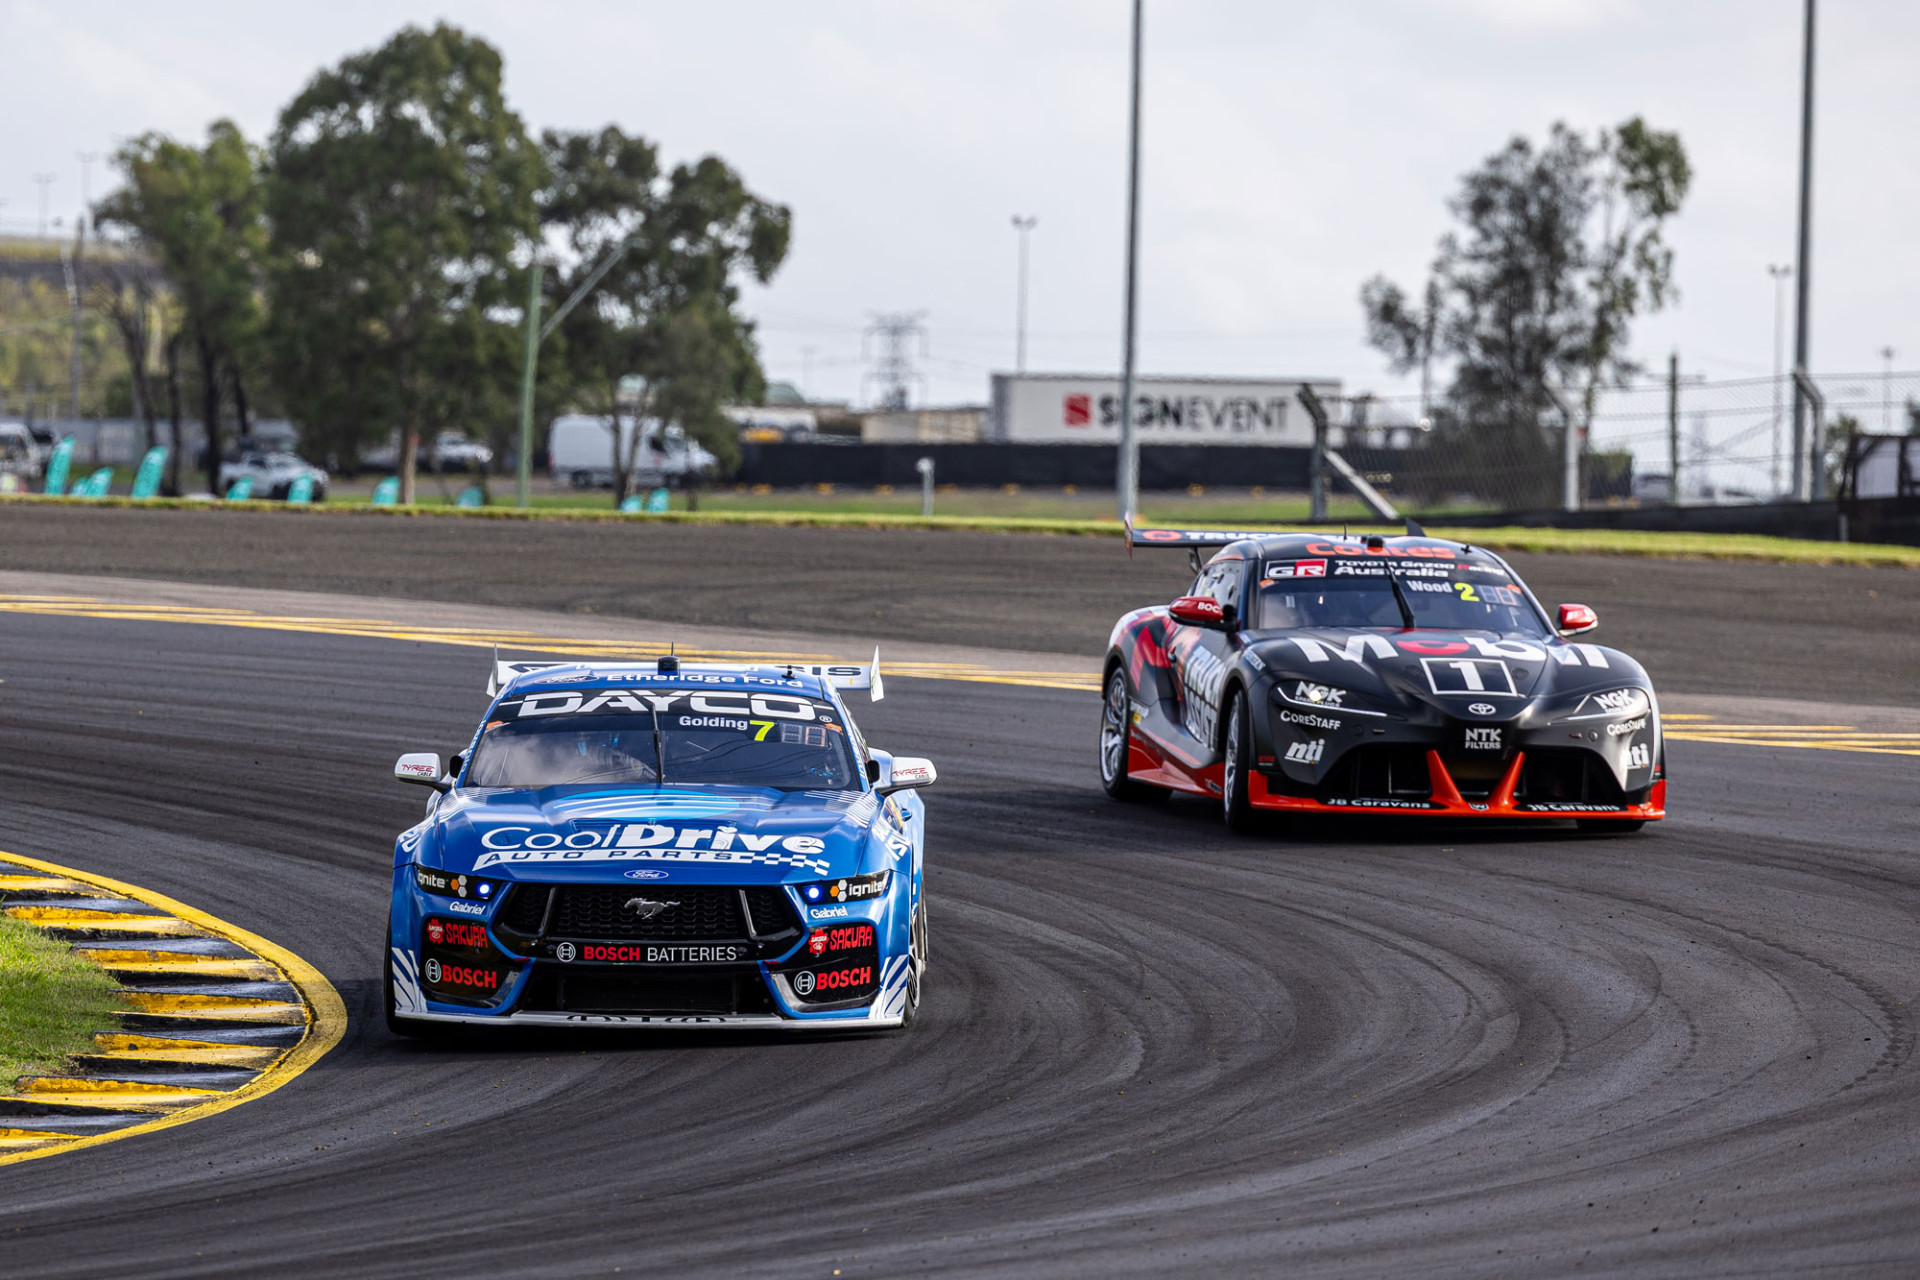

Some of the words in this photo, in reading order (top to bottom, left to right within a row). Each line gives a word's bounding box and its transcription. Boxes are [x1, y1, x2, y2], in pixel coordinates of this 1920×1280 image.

[1098, 393, 1289, 430] SGNEVENT
[1305, 542, 1456, 560] Coates
[1268, 565, 1324, 578] GR
[1407, 580, 1453, 593] Wood
[1454, 582, 1480, 602] 2
[1197, 601, 1221, 613] BOC
[1288, 632, 1610, 669] Mobil
[606, 673, 738, 684] Etheridge
[744, 673, 804, 688] Ford
[1448, 660, 1485, 691] 1
[1295, 680, 1347, 703] NGK
[1592, 688, 1636, 710] NGK
[517, 688, 816, 722] DAYCO
[680, 715, 748, 731] Golding
[750, 719, 776, 742] 7
[1465, 727, 1502, 742] NTK
[1285, 738, 1326, 761] nti
[1464, 741, 1502, 750] FILTERS
[401, 763, 436, 773] TYREE
[1351, 799, 1431, 809] Caravans
[483, 852, 584, 865] AUTO
[607, 850, 734, 861] PARTS
[848, 879, 882, 897] ignite
[449, 900, 486, 915] Gabriel
[809, 905, 849, 919] Gabriel
[445, 922, 489, 949] SAKURA
[829, 925, 873, 951] SAKURA
[583, 945, 641, 961] BOSCH
[647, 946, 737, 962] BATTERIES
[441, 964, 497, 989] BOSCH
[816, 966, 872, 990] BOSCH
